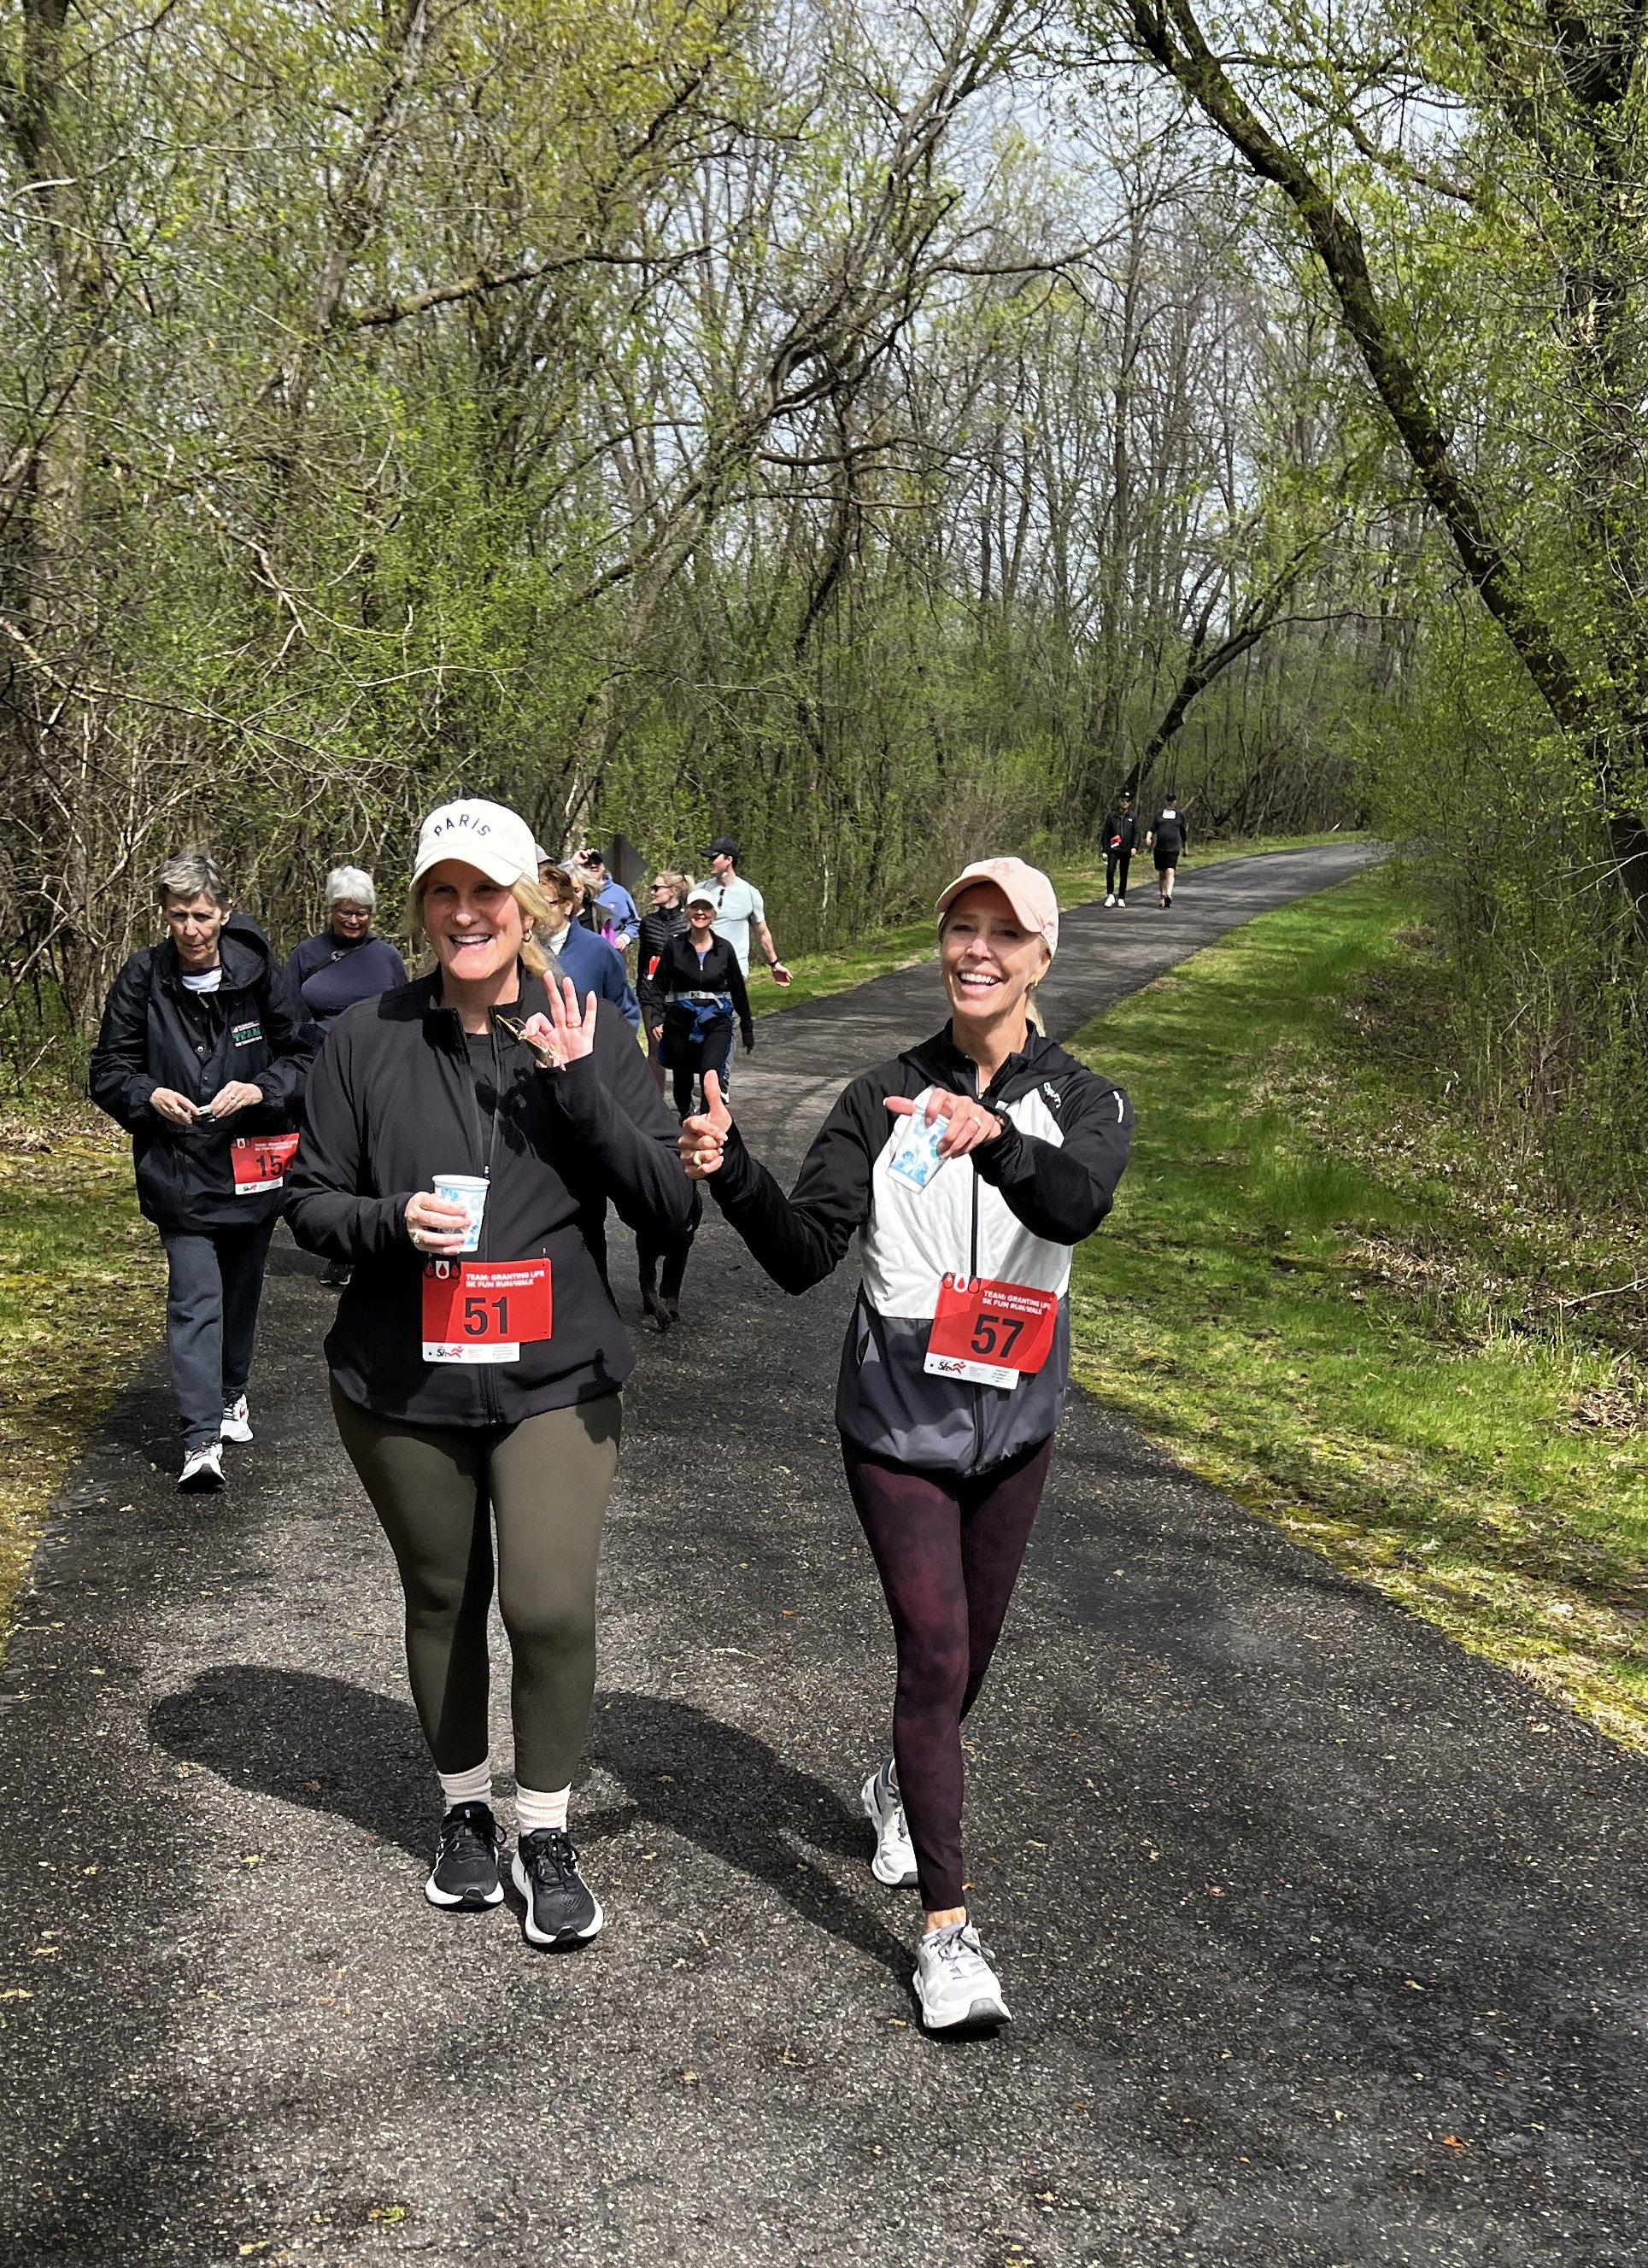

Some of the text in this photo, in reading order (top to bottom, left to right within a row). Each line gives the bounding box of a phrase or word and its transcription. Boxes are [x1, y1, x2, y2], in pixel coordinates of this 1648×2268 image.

[433, 813, 491, 836] PARIS
[255, 1154, 284, 1177] 15
[490, 1271, 529, 1281] GRANTING
[530, 1269, 545, 1278] LIFE
[496, 1279, 534, 1287] RUN/WALK
[983, 1290, 1052, 1310] TEAM: GRANTING LIFE
[993, 1299, 1009, 1309] FUN
[1010, 1302, 1042, 1315] RUN/WALK
[463, 1296, 508, 1335] 51
[971, 1313, 1024, 1358] 57
